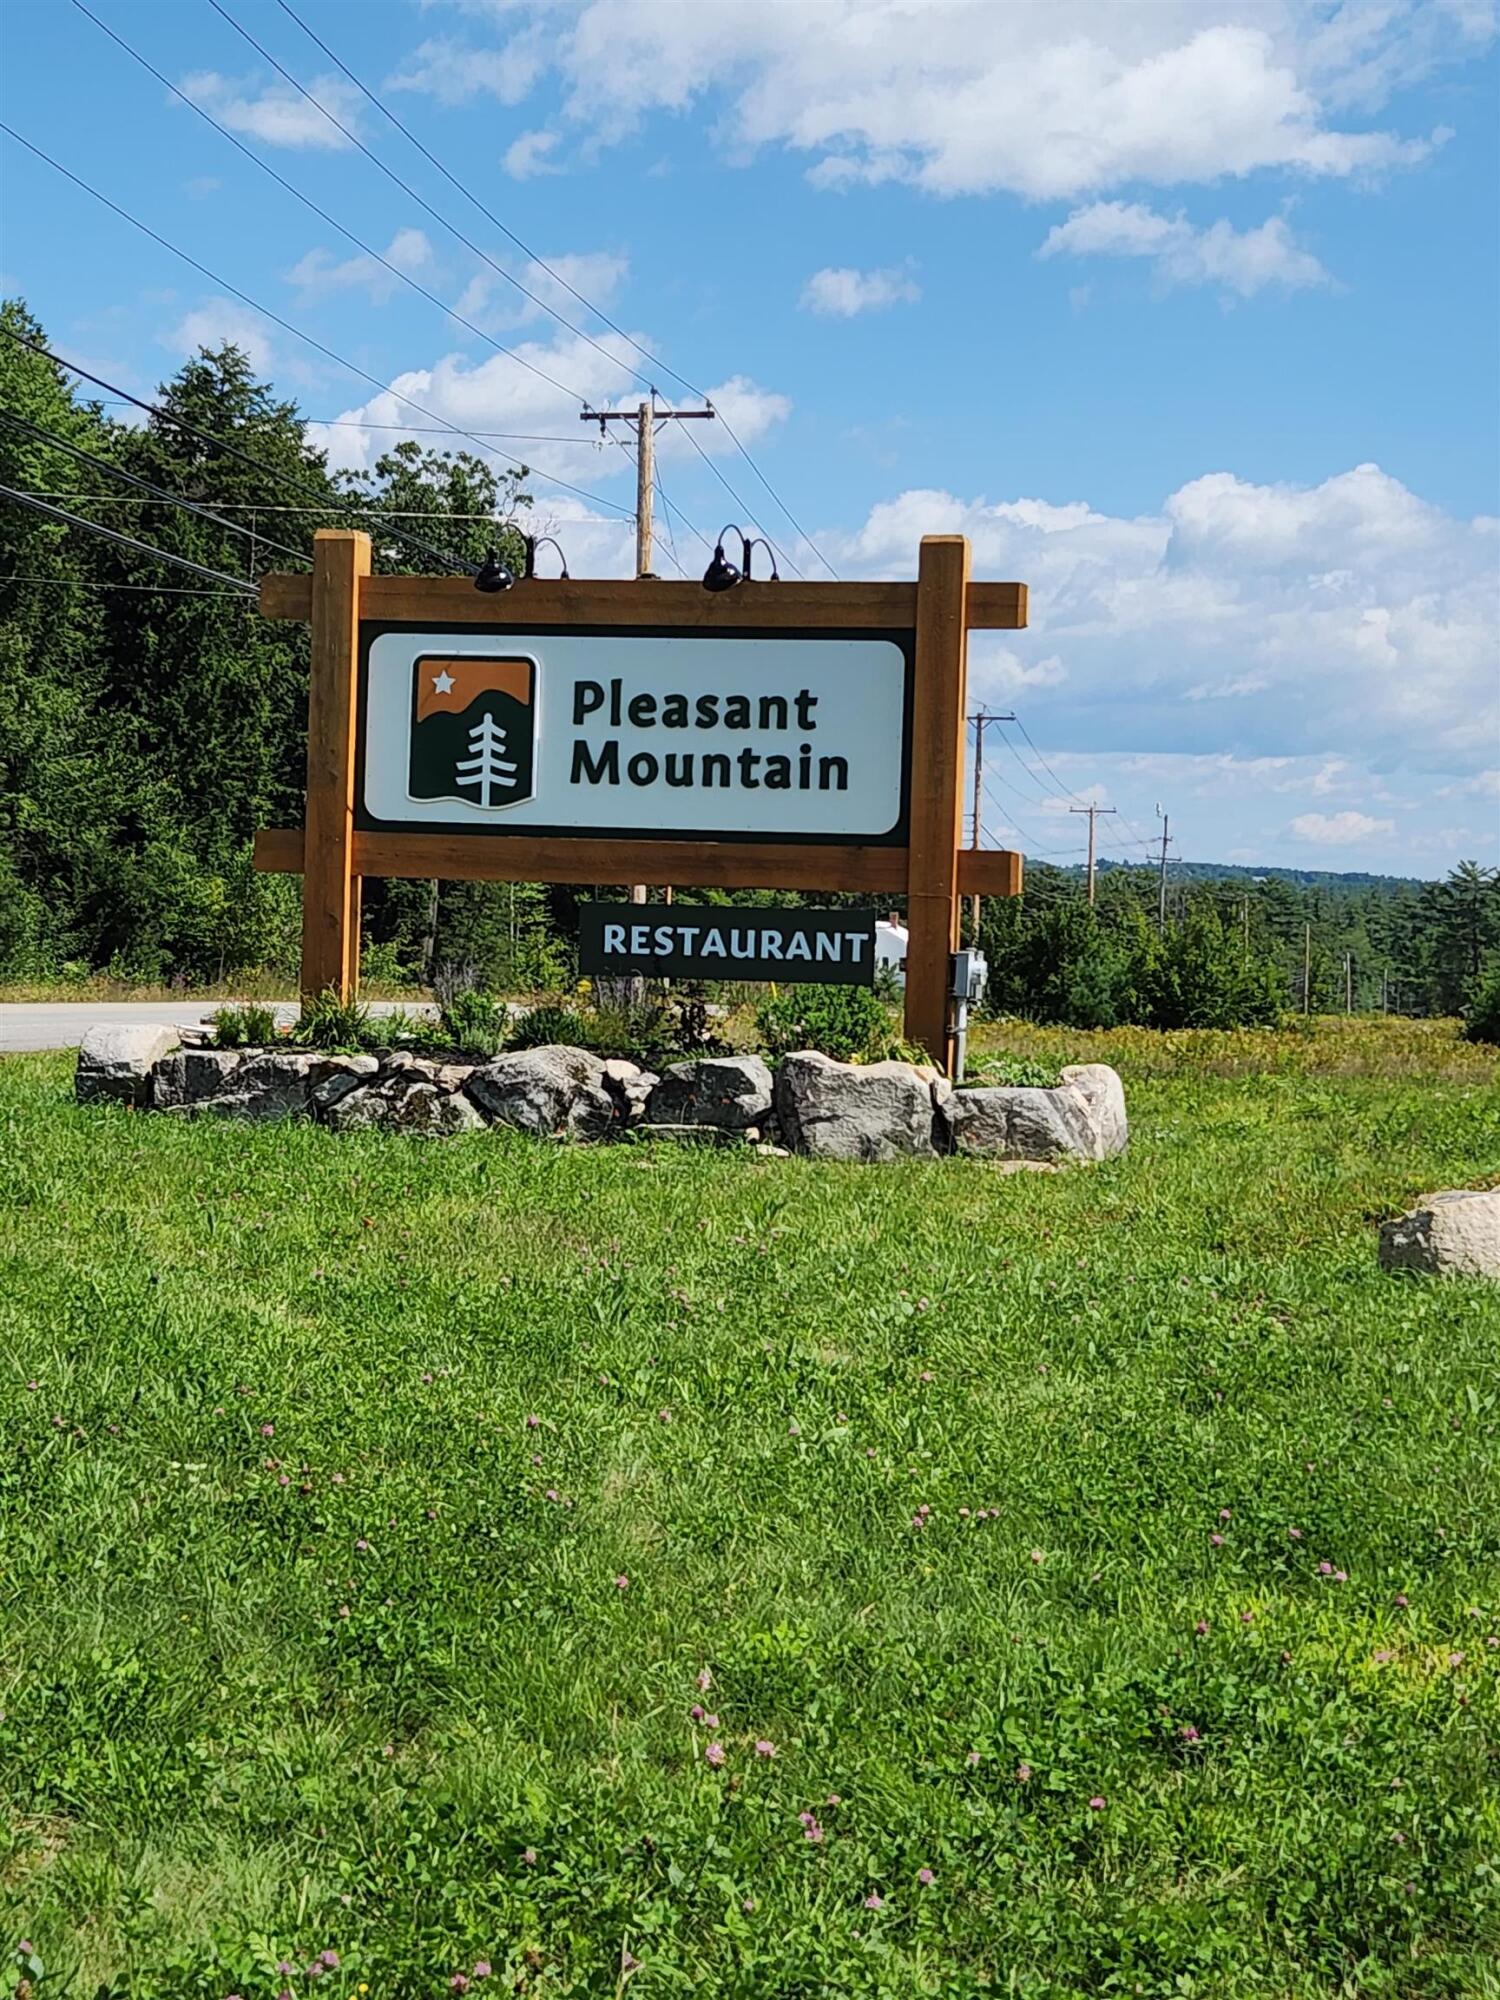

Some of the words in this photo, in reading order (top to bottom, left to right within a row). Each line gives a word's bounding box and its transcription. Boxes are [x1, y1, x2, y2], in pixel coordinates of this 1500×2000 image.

[573, 678, 818, 730] Pleasant
[570, 739, 849, 790] Mountain
[603, 924, 869, 963] RESTAURANT
